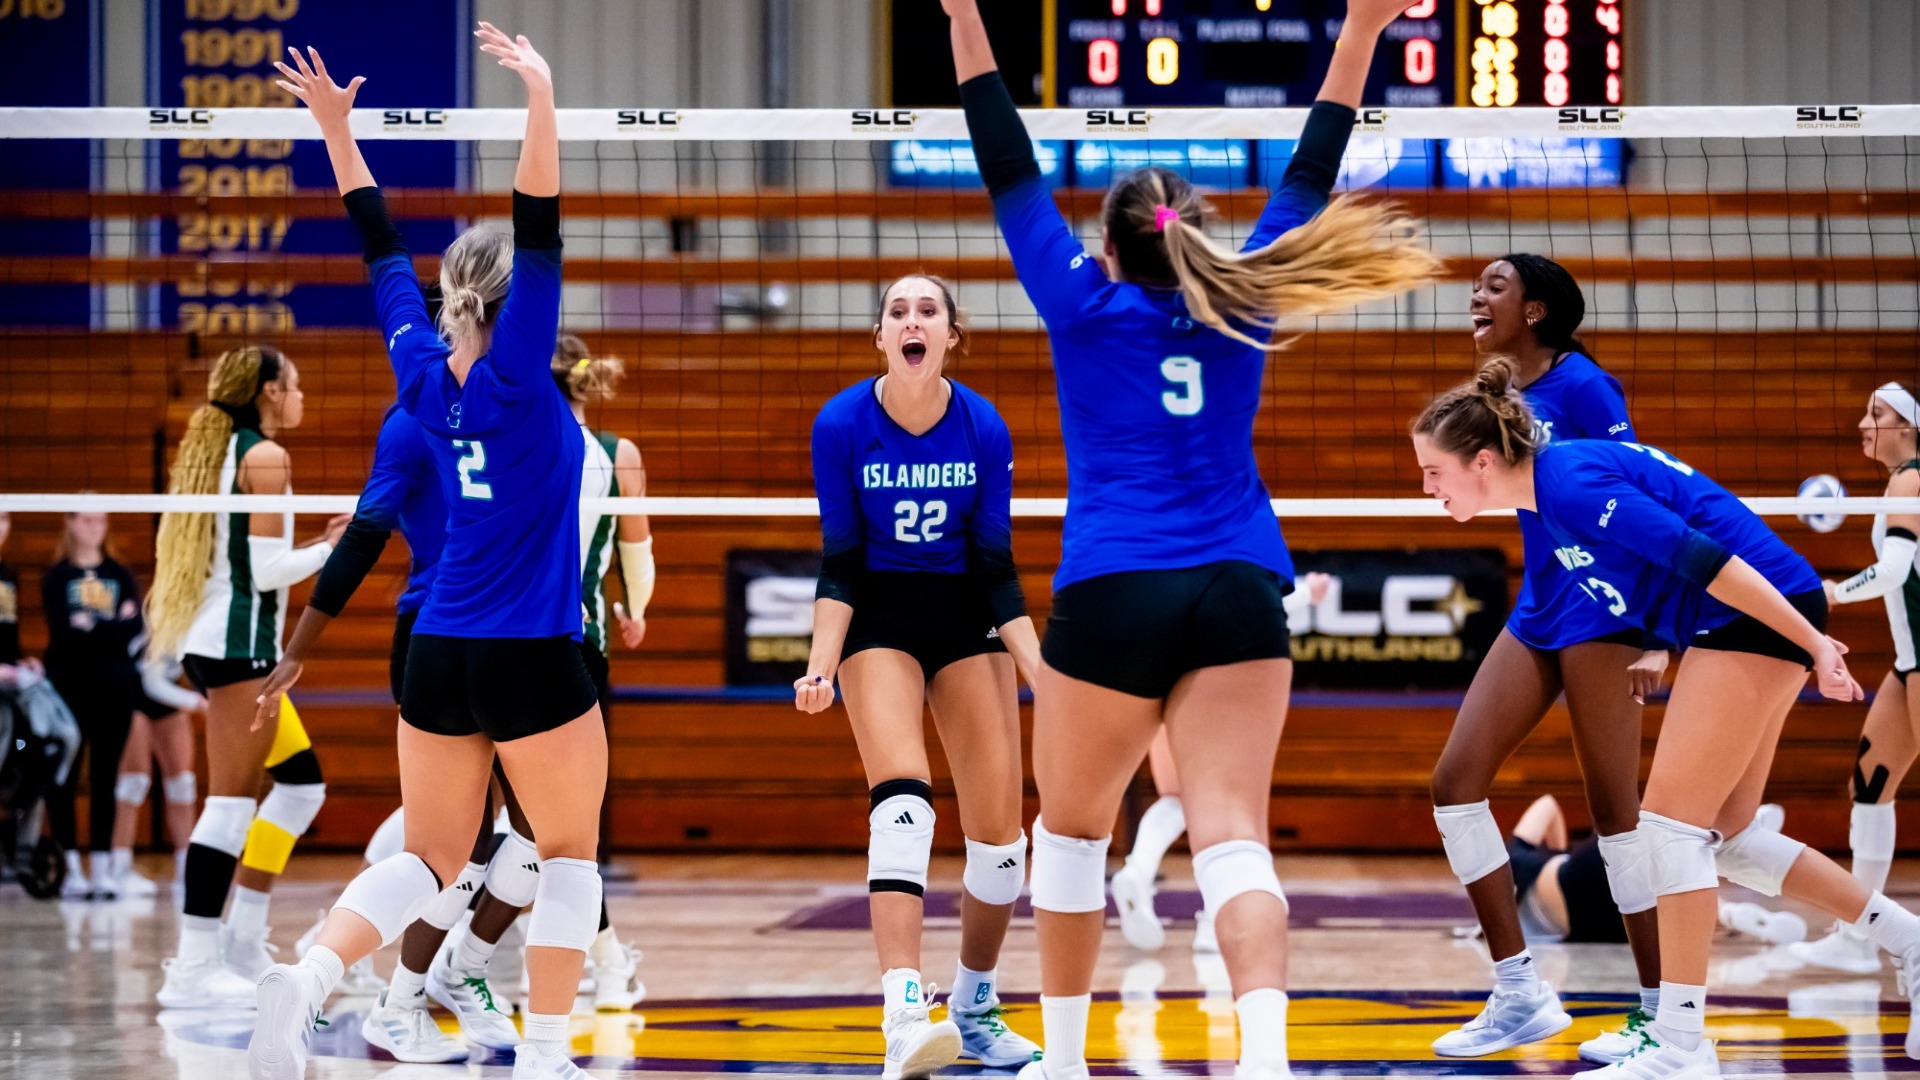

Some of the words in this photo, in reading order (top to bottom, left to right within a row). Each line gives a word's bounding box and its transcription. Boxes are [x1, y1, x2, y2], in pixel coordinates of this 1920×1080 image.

[182, 27, 283, 67] 1991
[1088, 38, 1119, 85] 0
[1147, 37, 1179, 85] 0
[1404, 38, 1436, 84] 0
[149, 110, 209, 124] SLC
[384, 110, 443, 125] SLC
[617, 110, 677, 125] SLC
[852, 110, 911, 125] SLC
[1086, 110, 1146, 125] SLC
[1558, 108, 1619, 123] SLC
[1796, 106, 1858, 121] SLC
[1161, 356, 1204, 416] 9
[1608, 421, 1630, 436] SLC
[452, 439, 493, 500] 2
[863, 461, 977, 488] ISLANDERS
[894, 500, 948, 542] 22
[1284, 574, 1455, 636] LC
